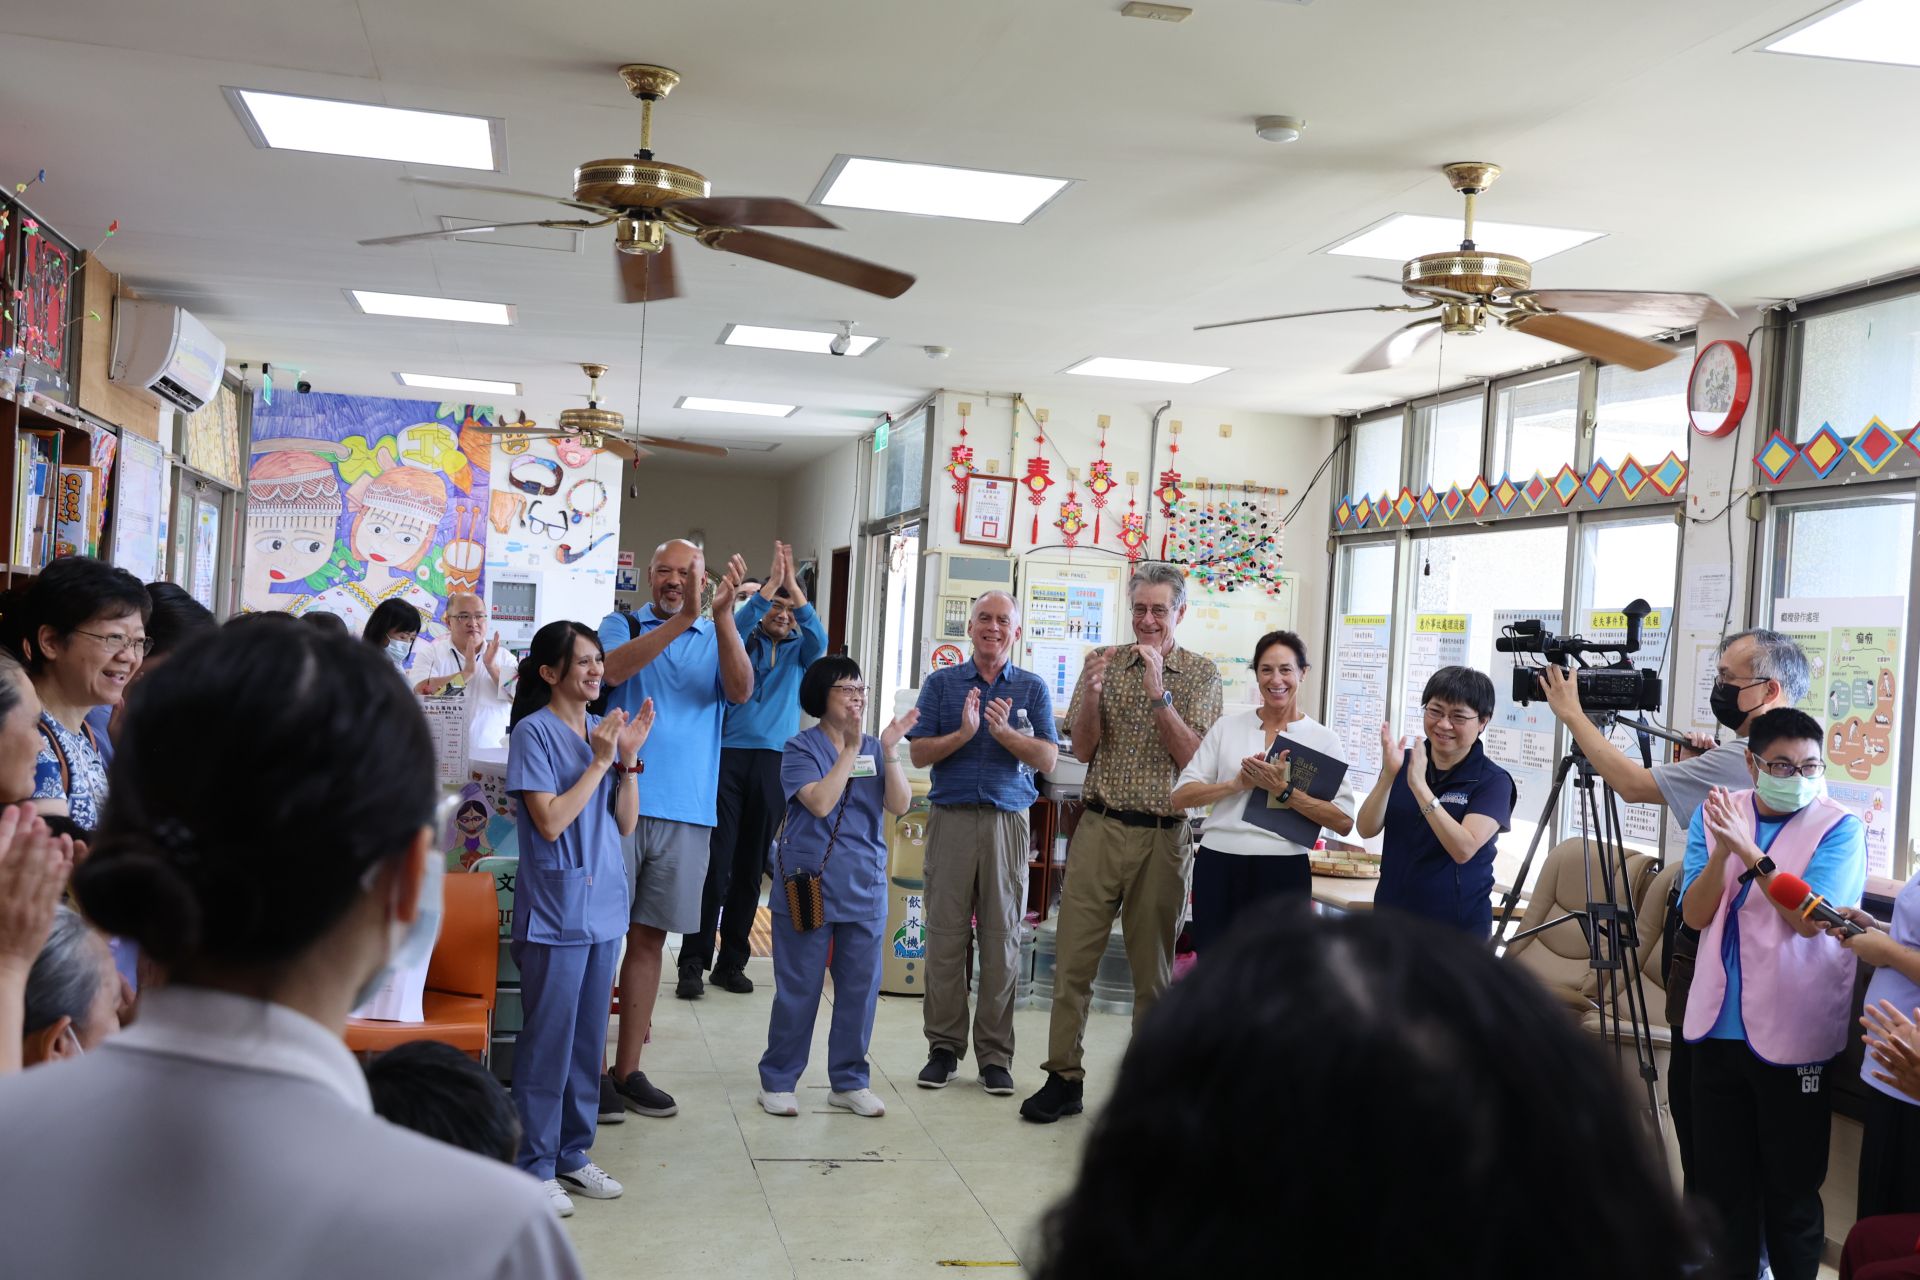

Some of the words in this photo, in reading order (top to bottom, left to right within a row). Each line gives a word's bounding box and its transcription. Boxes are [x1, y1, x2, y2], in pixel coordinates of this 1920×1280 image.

[1592, 615, 1660, 627] 走失事件緊流程
[906, 895, 921, 949] 飲水機
[1796, 1066, 1823, 1076] READY
[1801, 1075, 1820, 1093] GO
